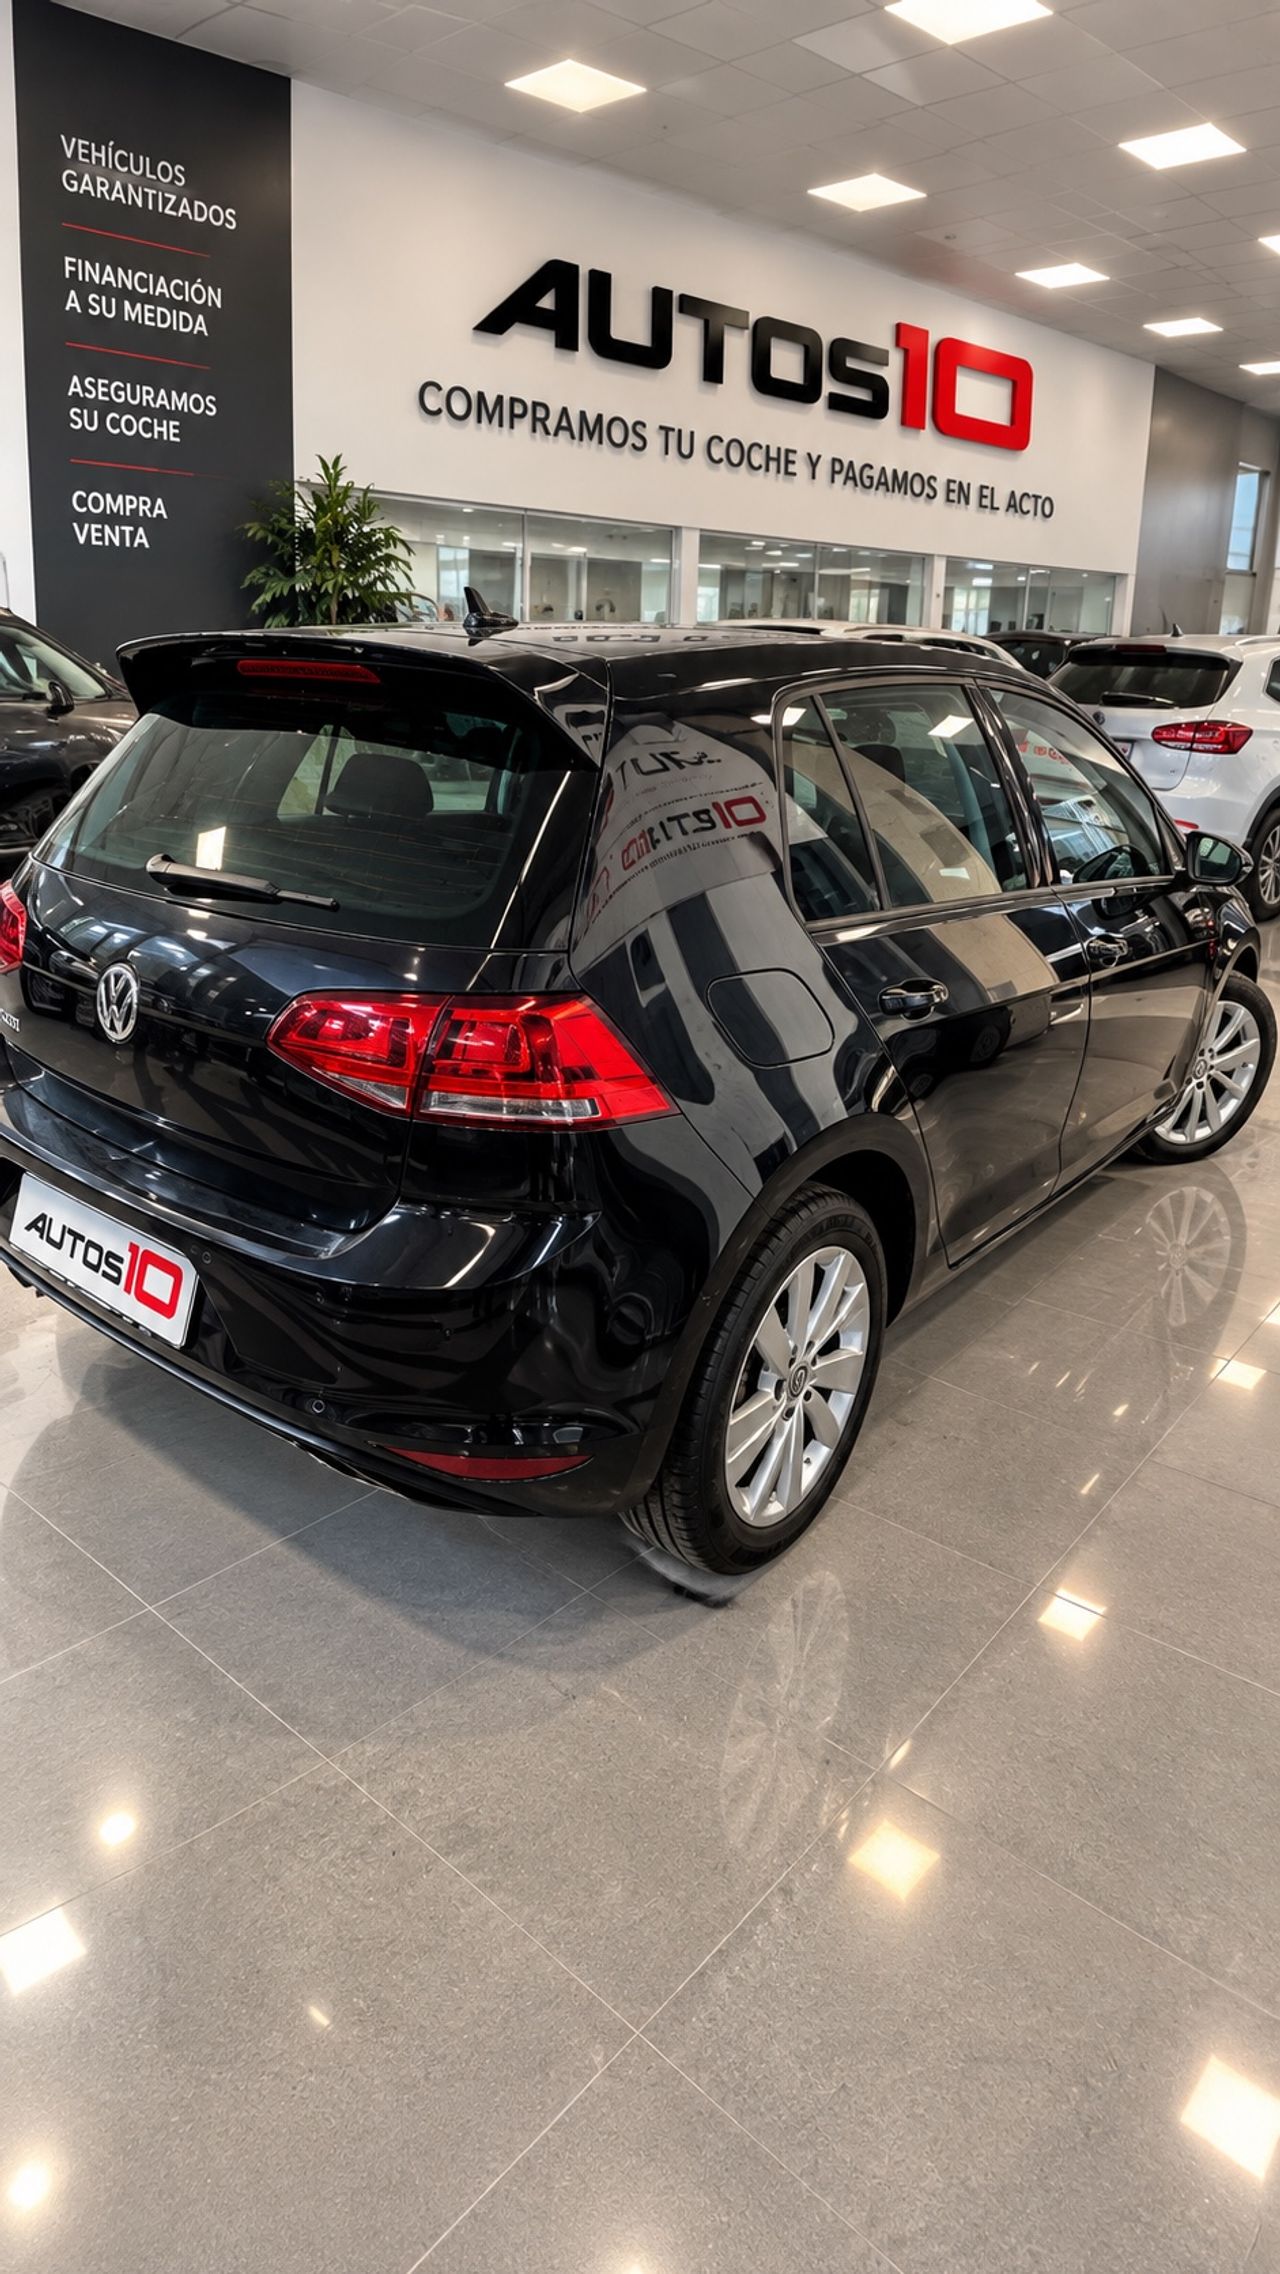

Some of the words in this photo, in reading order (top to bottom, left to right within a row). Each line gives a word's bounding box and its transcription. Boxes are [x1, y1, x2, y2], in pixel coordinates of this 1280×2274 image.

[60, 134, 186, 187] VEHÍCULOS
[61, 169, 237, 230] GARANTIZADOS
[64, 255, 222, 309] FINANCIACIÓN
[64, 289, 82, 314] A
[87, 293, 116, 319] SU
[123, 299, 209, 337] MEDIDA
[472, 258, 1034, 452] AUTOS10
[67, 374, 217, 417] ASEGURAMOS
[69, 407, 99, 432] SU
[105, 412, 181, 443] COCHE
[418, 381, 647, 452] COMPRAMOS
[658, 425, 695, 460] TU
[706, 435, 797, 477] COCHE
[806, 452, 822, 480] Y
[830, 457, 938, 501] PAGAMOS
[945, 478, 971, 506] EN
[978, 484, 1000, 512] EL
[1006, 490, 1054, 519] ACTO
[71, 490, 168, 520] COMPRA
[72, 522, 150, 549] VENTA
[24, 1211, 184, 1320] AUTOS10
